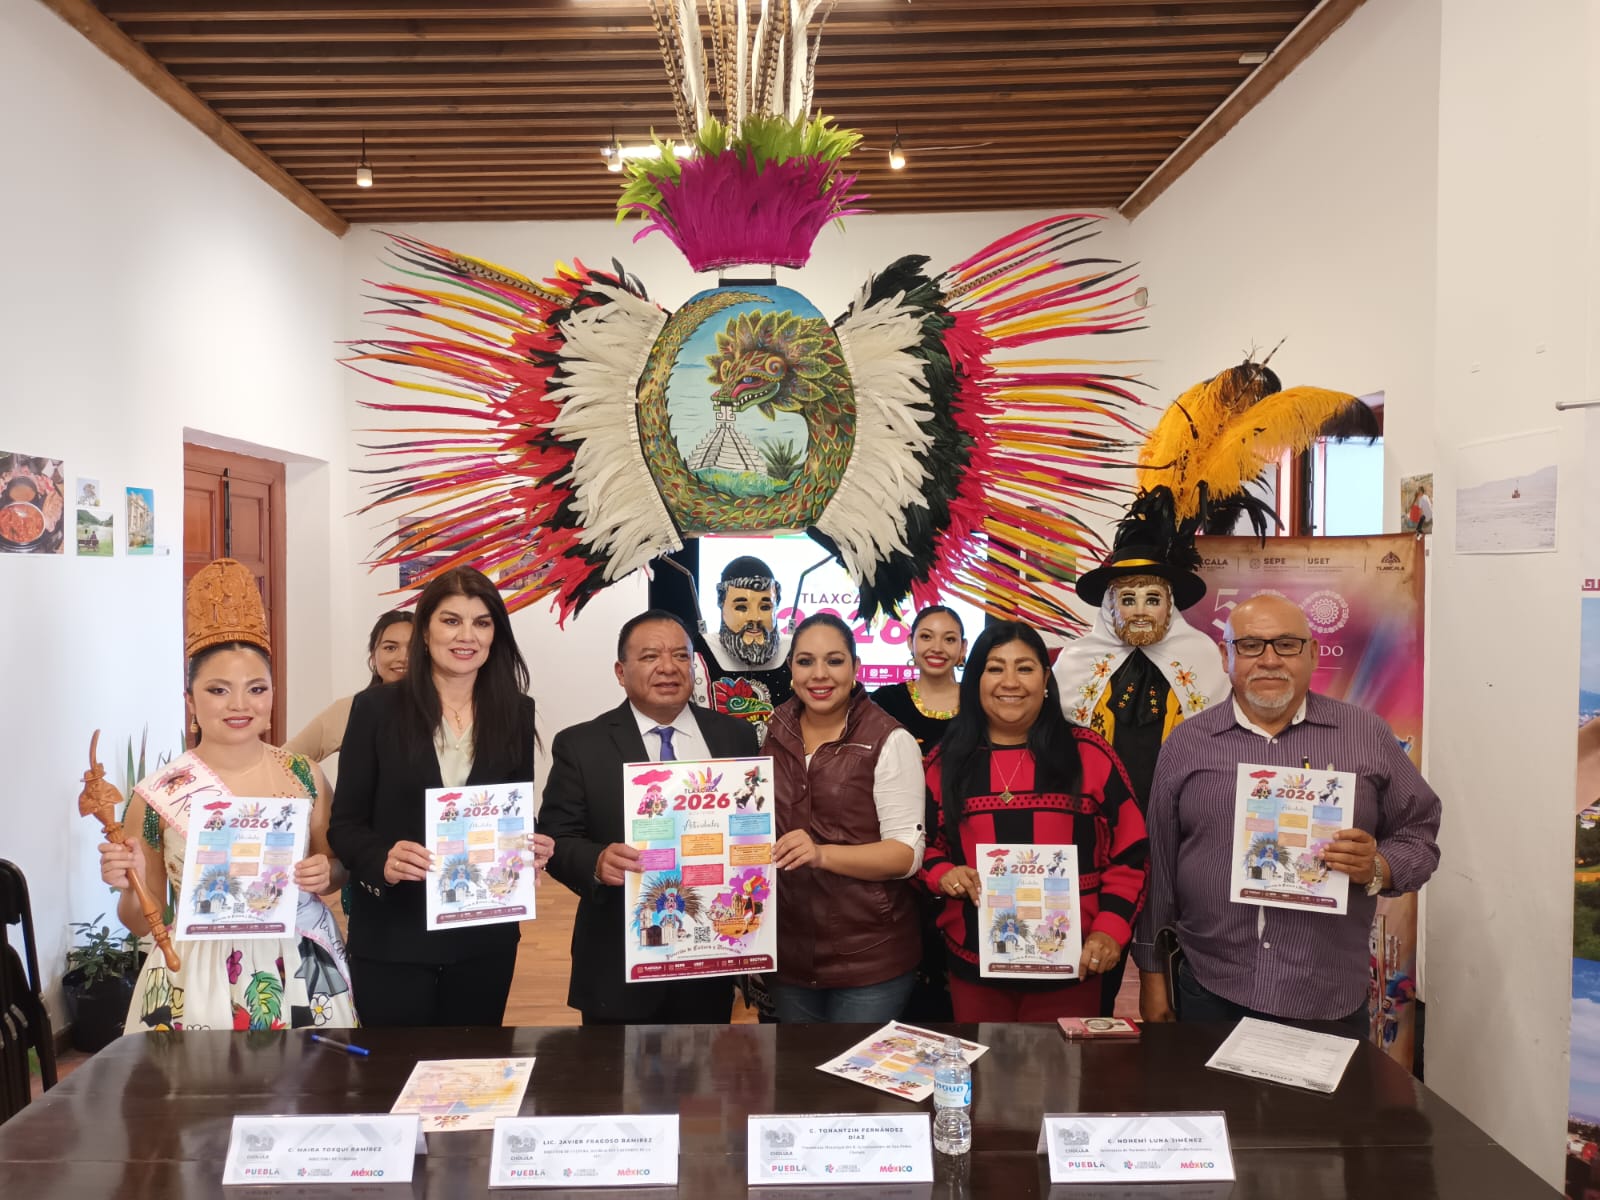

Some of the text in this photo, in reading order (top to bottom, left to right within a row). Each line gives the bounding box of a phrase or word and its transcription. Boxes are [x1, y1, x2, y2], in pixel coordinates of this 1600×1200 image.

[1263, 557, 1286, 565] SEPE
[1307, 557, 1330, 565] USET
[801, 592, 861, 604] TLAXCA
[1275, 788, 1315, 801] 2026
[673, 793, 731, 811] 2026
[463, 805, 499, 817] 2026
[229, 818, 269, 828] 2026
[1010, 864, 1045, 874] 2026
[862, 1069, 899, 1082] 2026
[245, 1168, 280, 1176] PUEBLA
[510, 1169, 546, 1177] PUEBLA
[771, 1164, 807, 1172] PUEBLA
